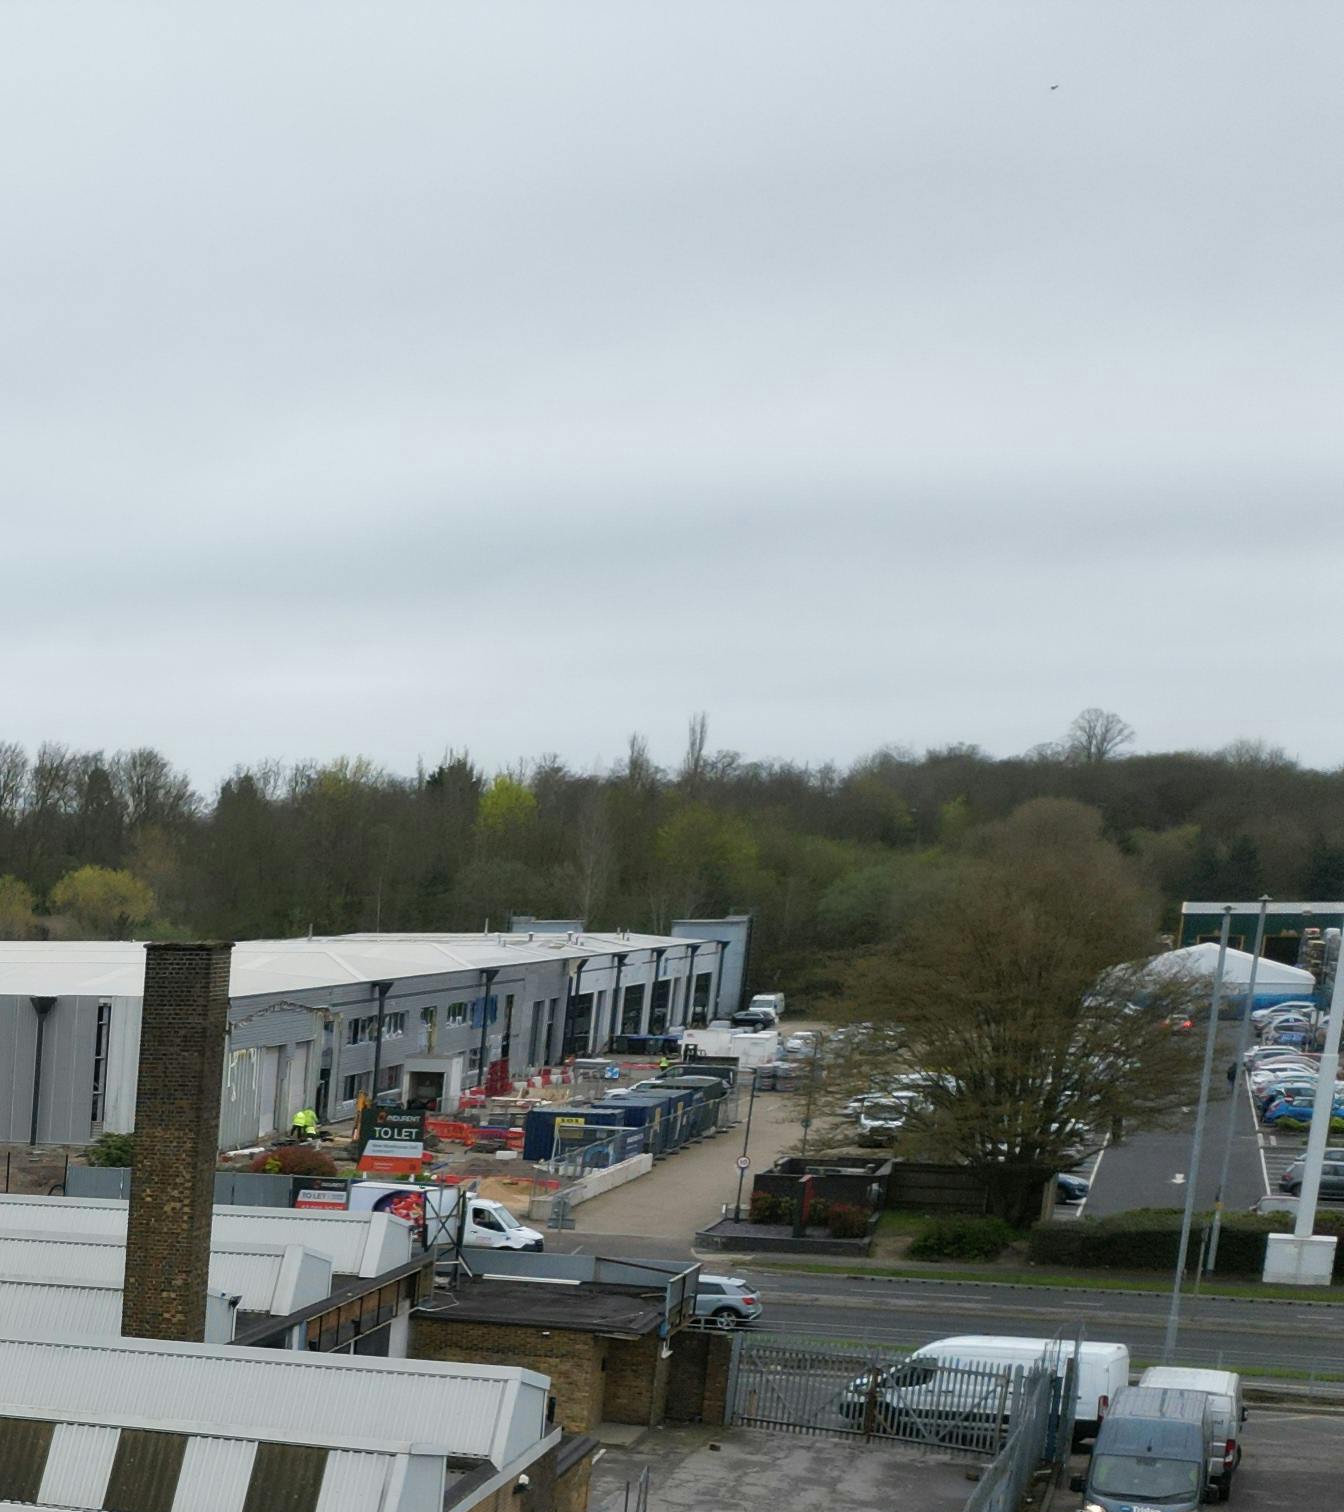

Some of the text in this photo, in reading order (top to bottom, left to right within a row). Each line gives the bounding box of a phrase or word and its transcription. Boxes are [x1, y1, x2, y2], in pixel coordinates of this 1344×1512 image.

[374, 1127, 419, 1140] TO LET
[313, 1192, 327, 1200] LET
